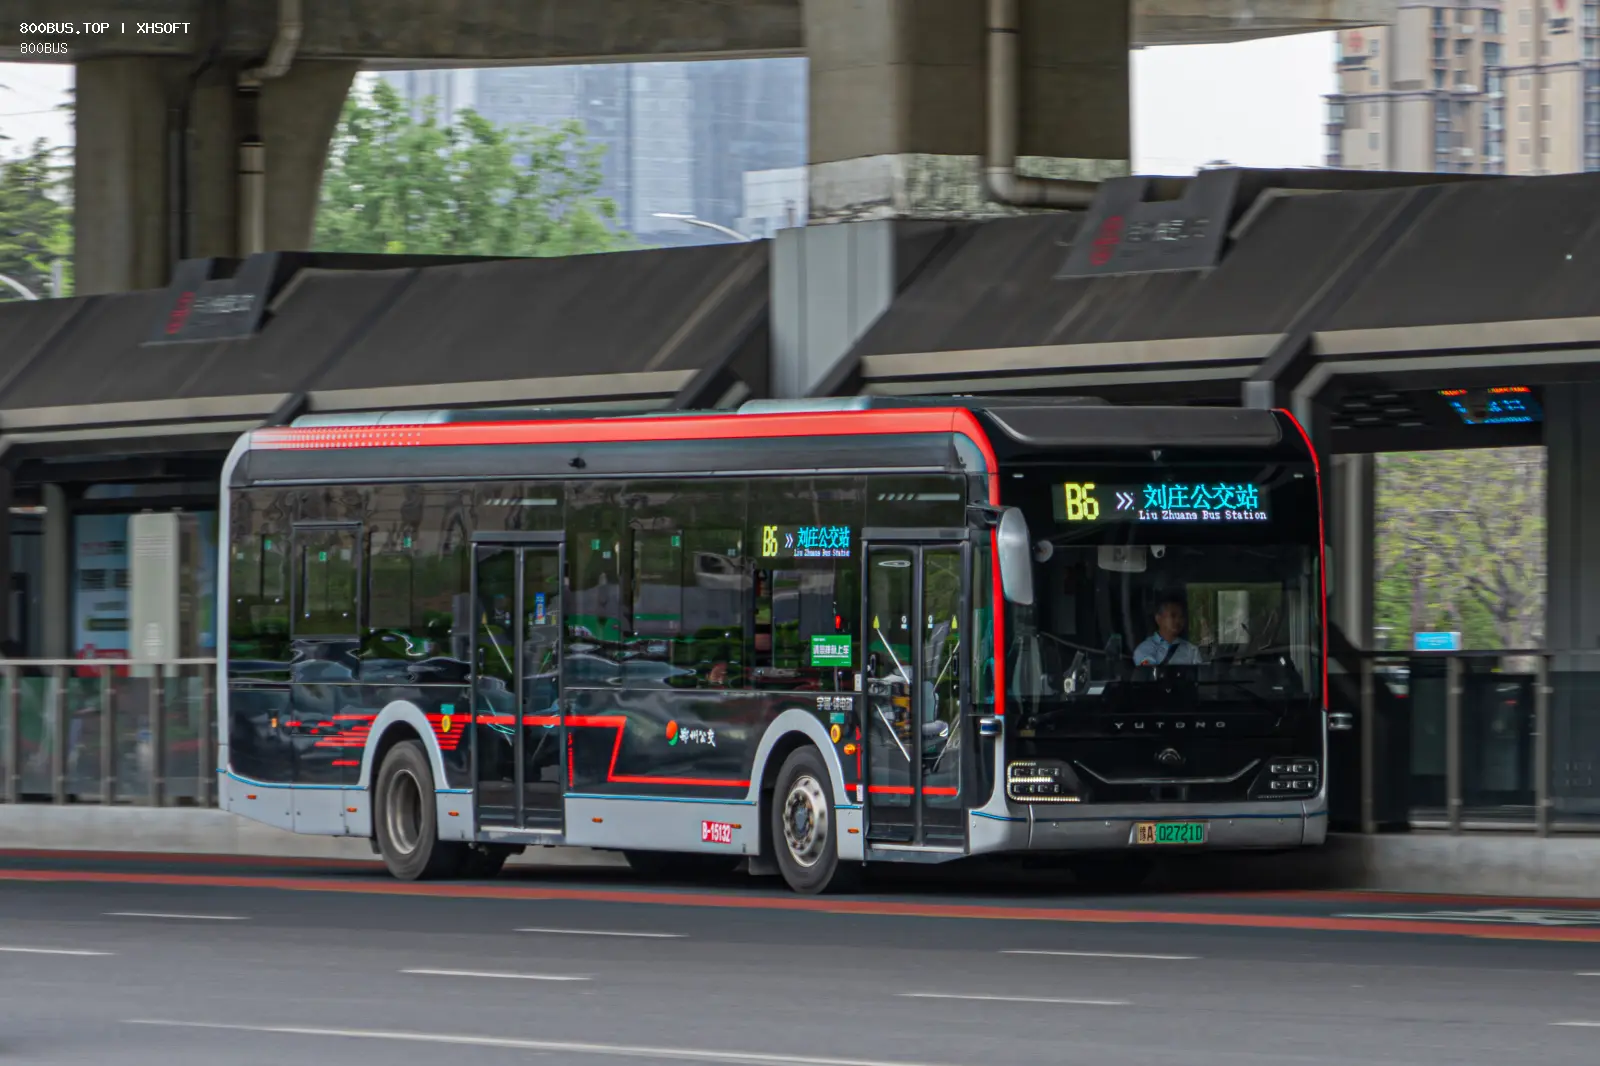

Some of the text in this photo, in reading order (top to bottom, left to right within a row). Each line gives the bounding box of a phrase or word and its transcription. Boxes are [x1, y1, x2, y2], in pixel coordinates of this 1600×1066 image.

[1065, 482, 1099, 520] B6
[1142, 483, 1259, 510] 刘庄公交站
[1138, 510, 1267, 520] Liu Zhuang Bus Station
[763, 525, 778, 556] B6
[797, 526, 850, 548] 刘庄公交站
[1114, 721, 1226, 729] YUTONG
[702, 821, 731, 843] B-15132
